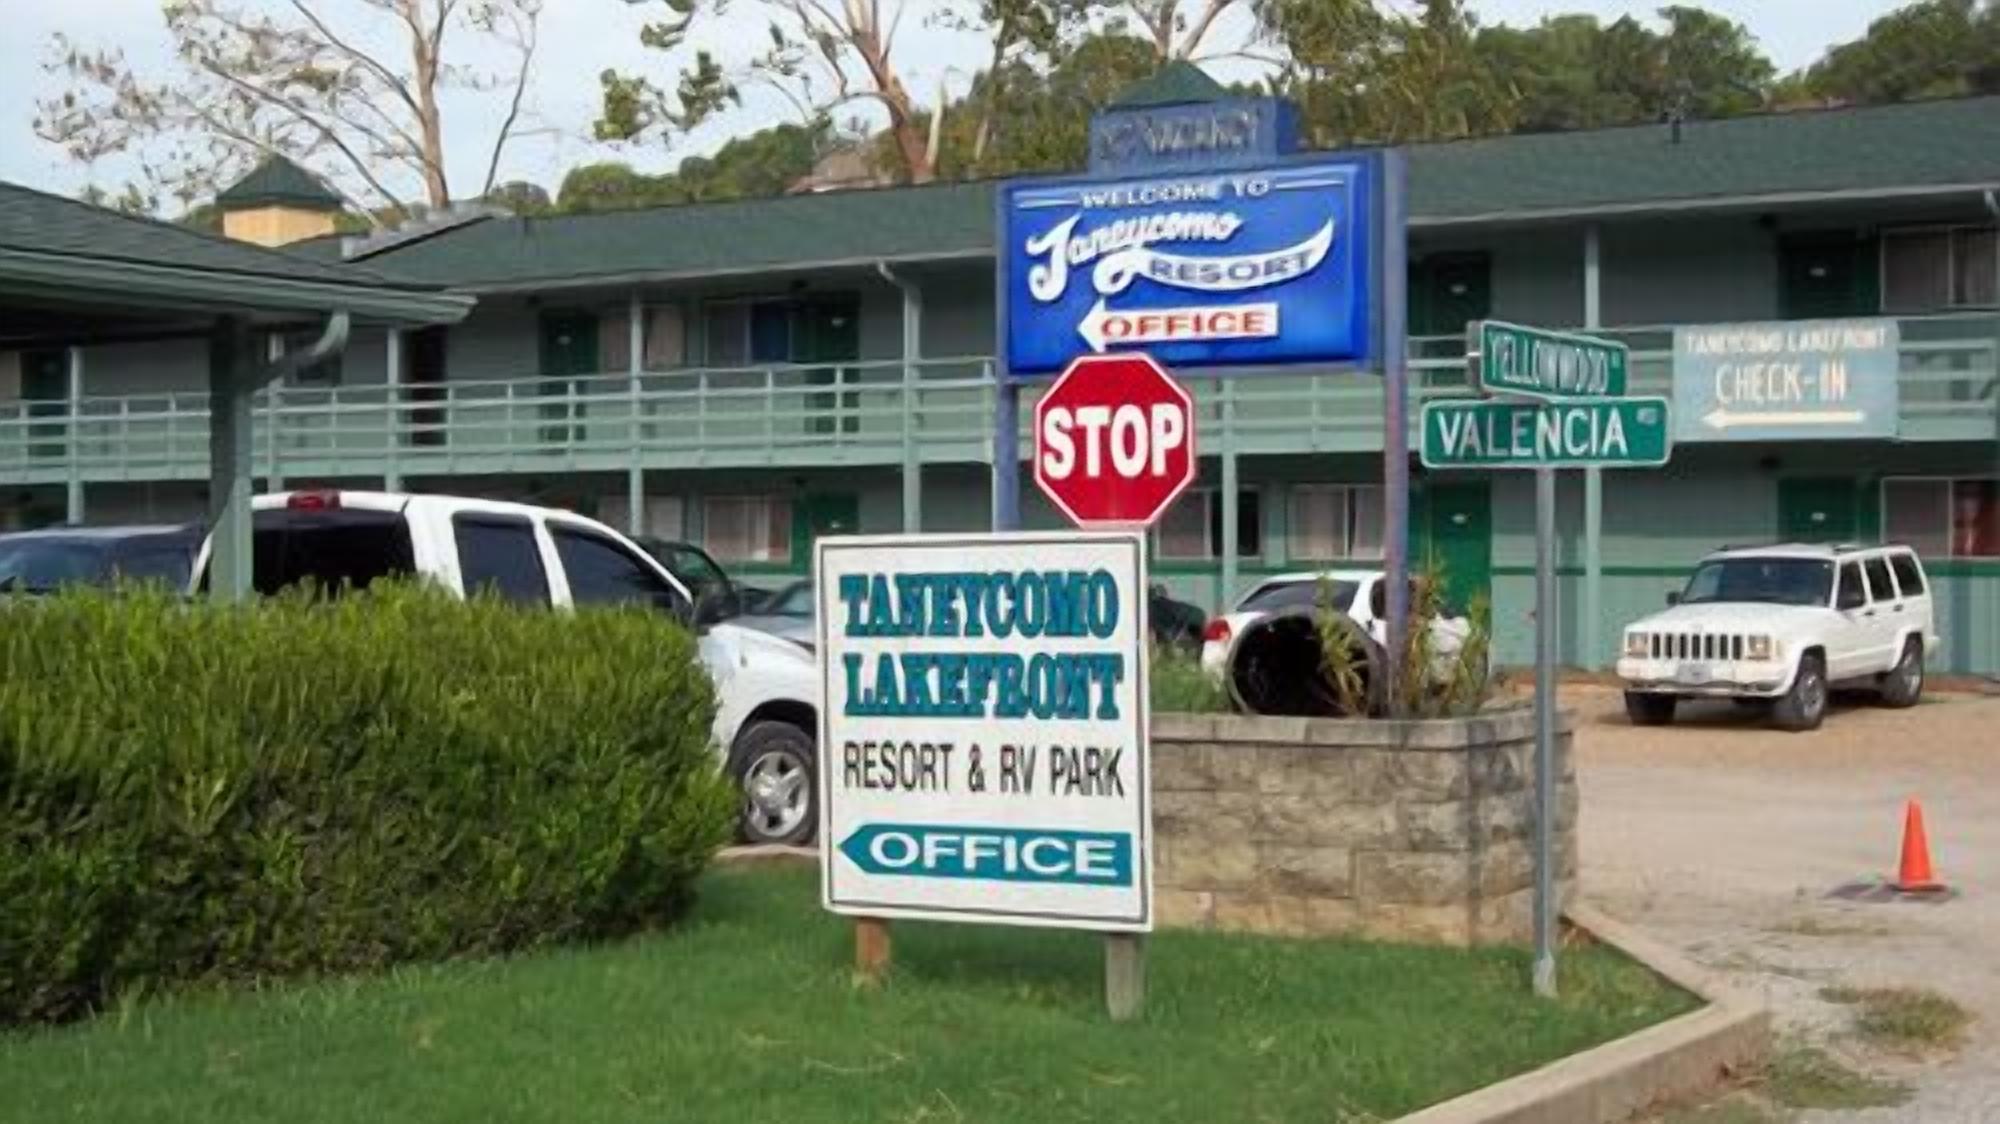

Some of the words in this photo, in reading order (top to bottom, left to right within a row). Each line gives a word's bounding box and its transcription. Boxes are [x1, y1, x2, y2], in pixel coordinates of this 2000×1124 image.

[1083, 183, 1220, 208] WELCOME
[1232, 175, 1270, 197] TO
[1027, 212, 1242, 301] Taneycomo
[1149, 252, 1314, 284] RESORT
[1101, 311, 1265, 343] OFFICE
[1715, 359, 1846, 404] CHECK-IN
[1043, 402, 1184, 480] STOP
[1436, 407, 1629, 459] VALENCIA
[839, 569, 1120, 639] TANEYCOMO
[843, 652, 1125, 720] LAKEFRONT
[844, 740, 955, 793] RESORT
[967, 743, 986, 793] &
[1000, 745, 1037, 795] RV
[1050, 746, 1125, 798] PARK
[869, 832, 1119, 877] OFFICE
